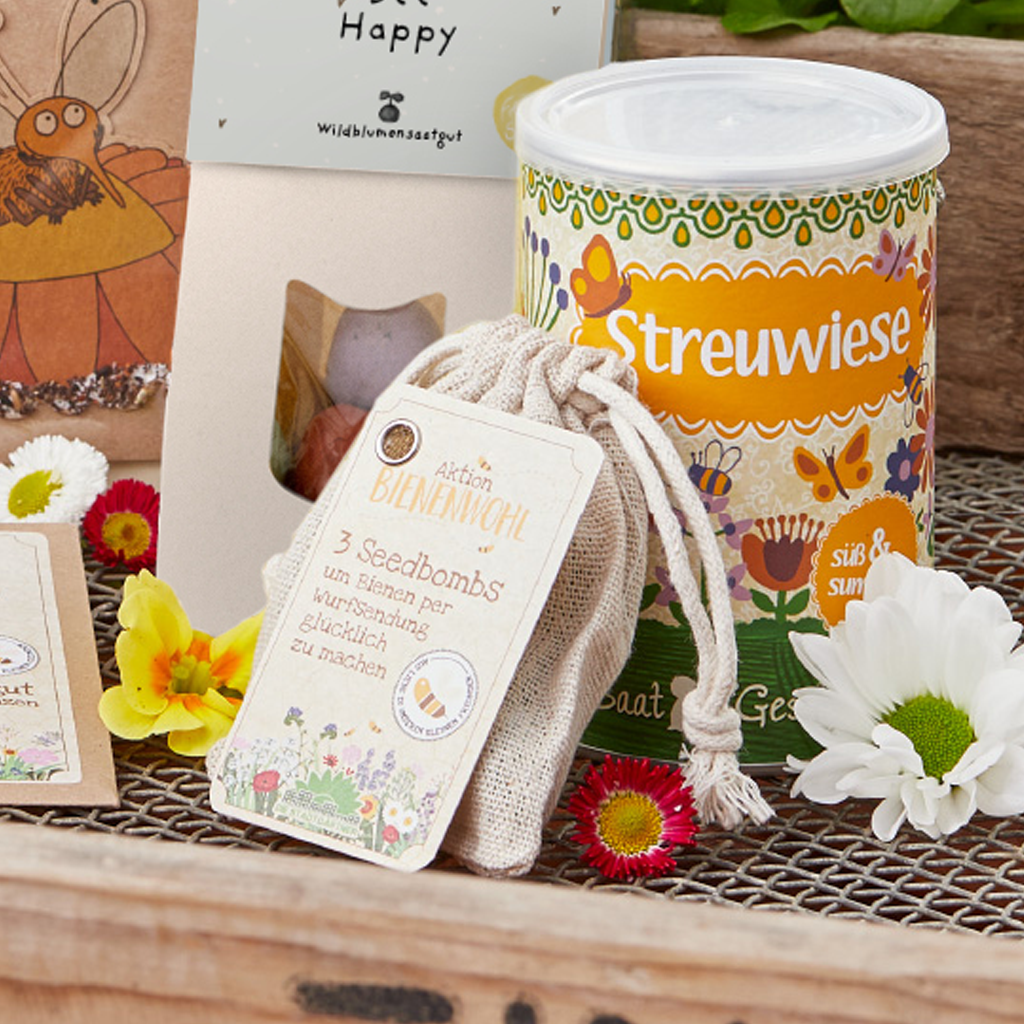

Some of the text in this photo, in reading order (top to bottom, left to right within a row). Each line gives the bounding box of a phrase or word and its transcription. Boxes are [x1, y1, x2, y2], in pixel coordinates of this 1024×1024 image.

[340, 11, 457, 56] Happy
[317, 120, 463, 148] Wildblumensaatgut
[606, 306, 911, 377] Streuwiese
[434, 461, 493, 492] Aktion
[369, 466, 530, 542] BIENENWOHL
[333, 530, 505, 602] 3 Seedbombs
[830, 527, 891, 567] süß &
[322, 565, 453, 615] um Bienen per
[827, 577, 865, 596] sum
[299, 612, 388, 652] glücklich
[290, 637, 387, 680] zu machen
[736, 684, 798, 728] Ges
